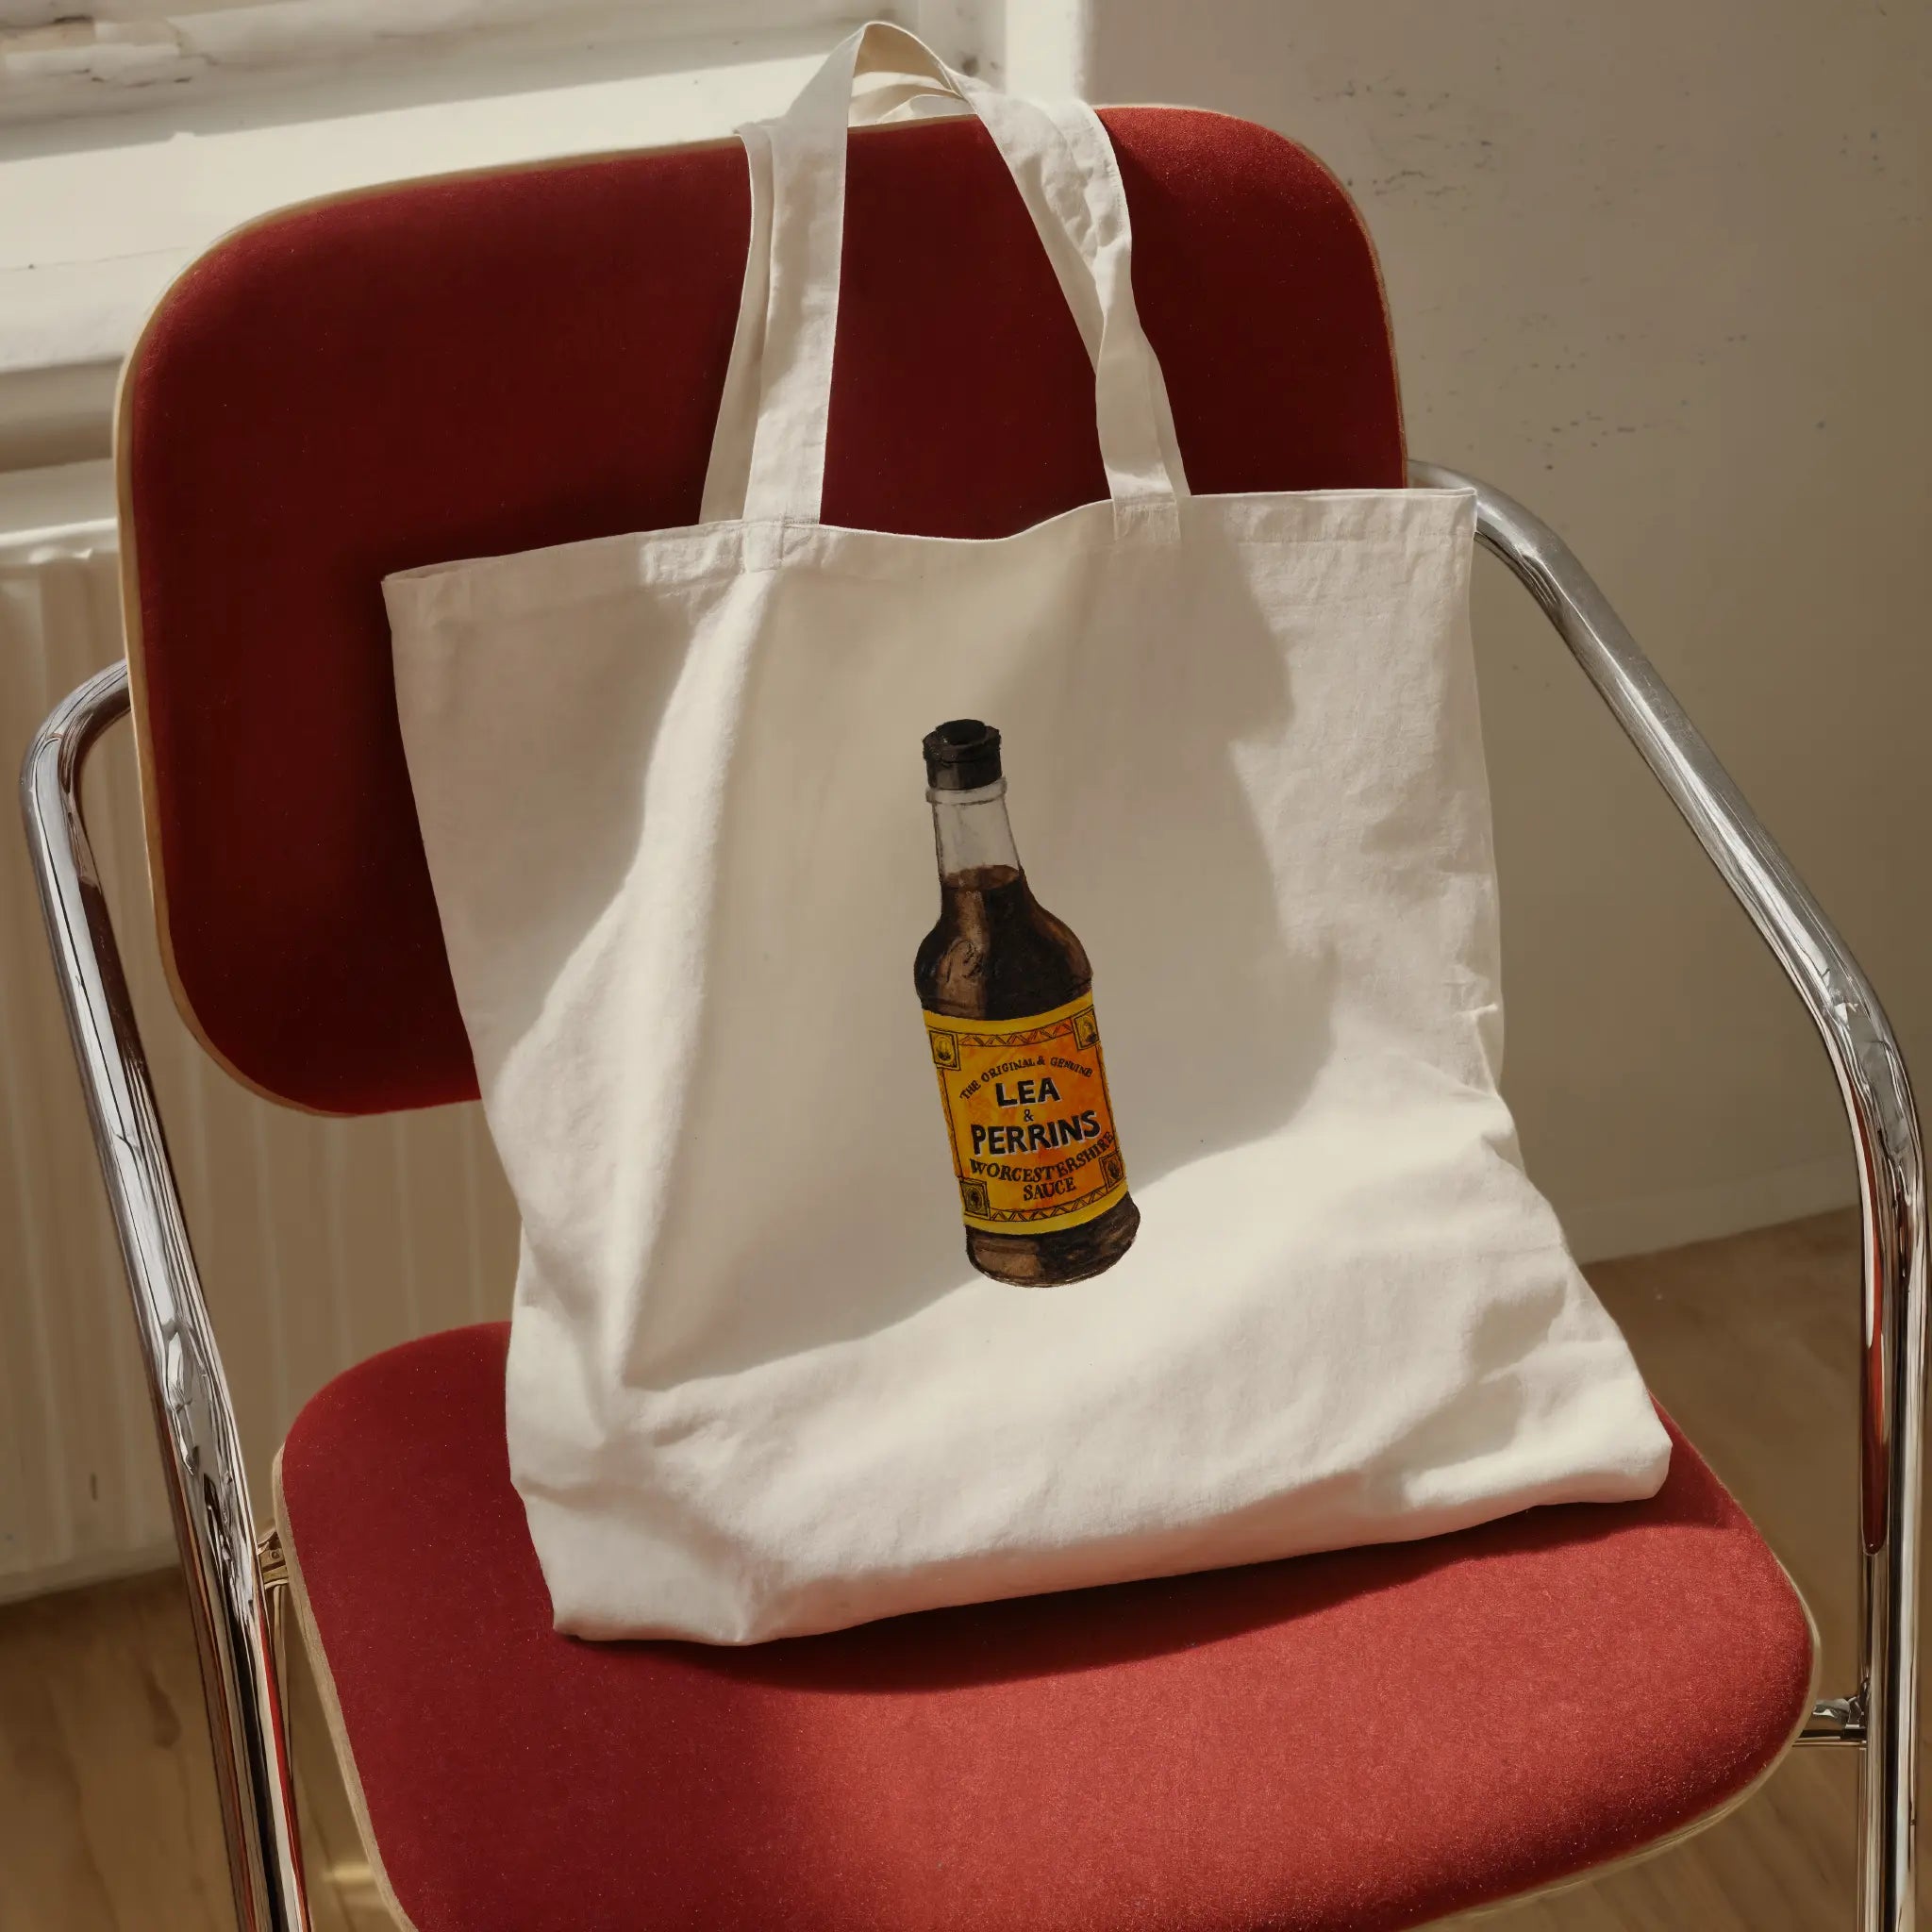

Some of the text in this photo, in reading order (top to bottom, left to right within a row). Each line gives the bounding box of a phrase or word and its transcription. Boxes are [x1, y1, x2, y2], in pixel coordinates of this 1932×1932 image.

[959, 1056, 1093, 1101] THE ORIGINAL & GENUINE
[995, 1077, 1061, 1108] LEA
[970, 1109, 1102, 1157] PERRINS
[1023, 1109, 1035, 1123] &
[970, 1131, 1115, 1183] WORCESTERSHIRE
[1023, 1176, 1076, 1202] SAUCE
